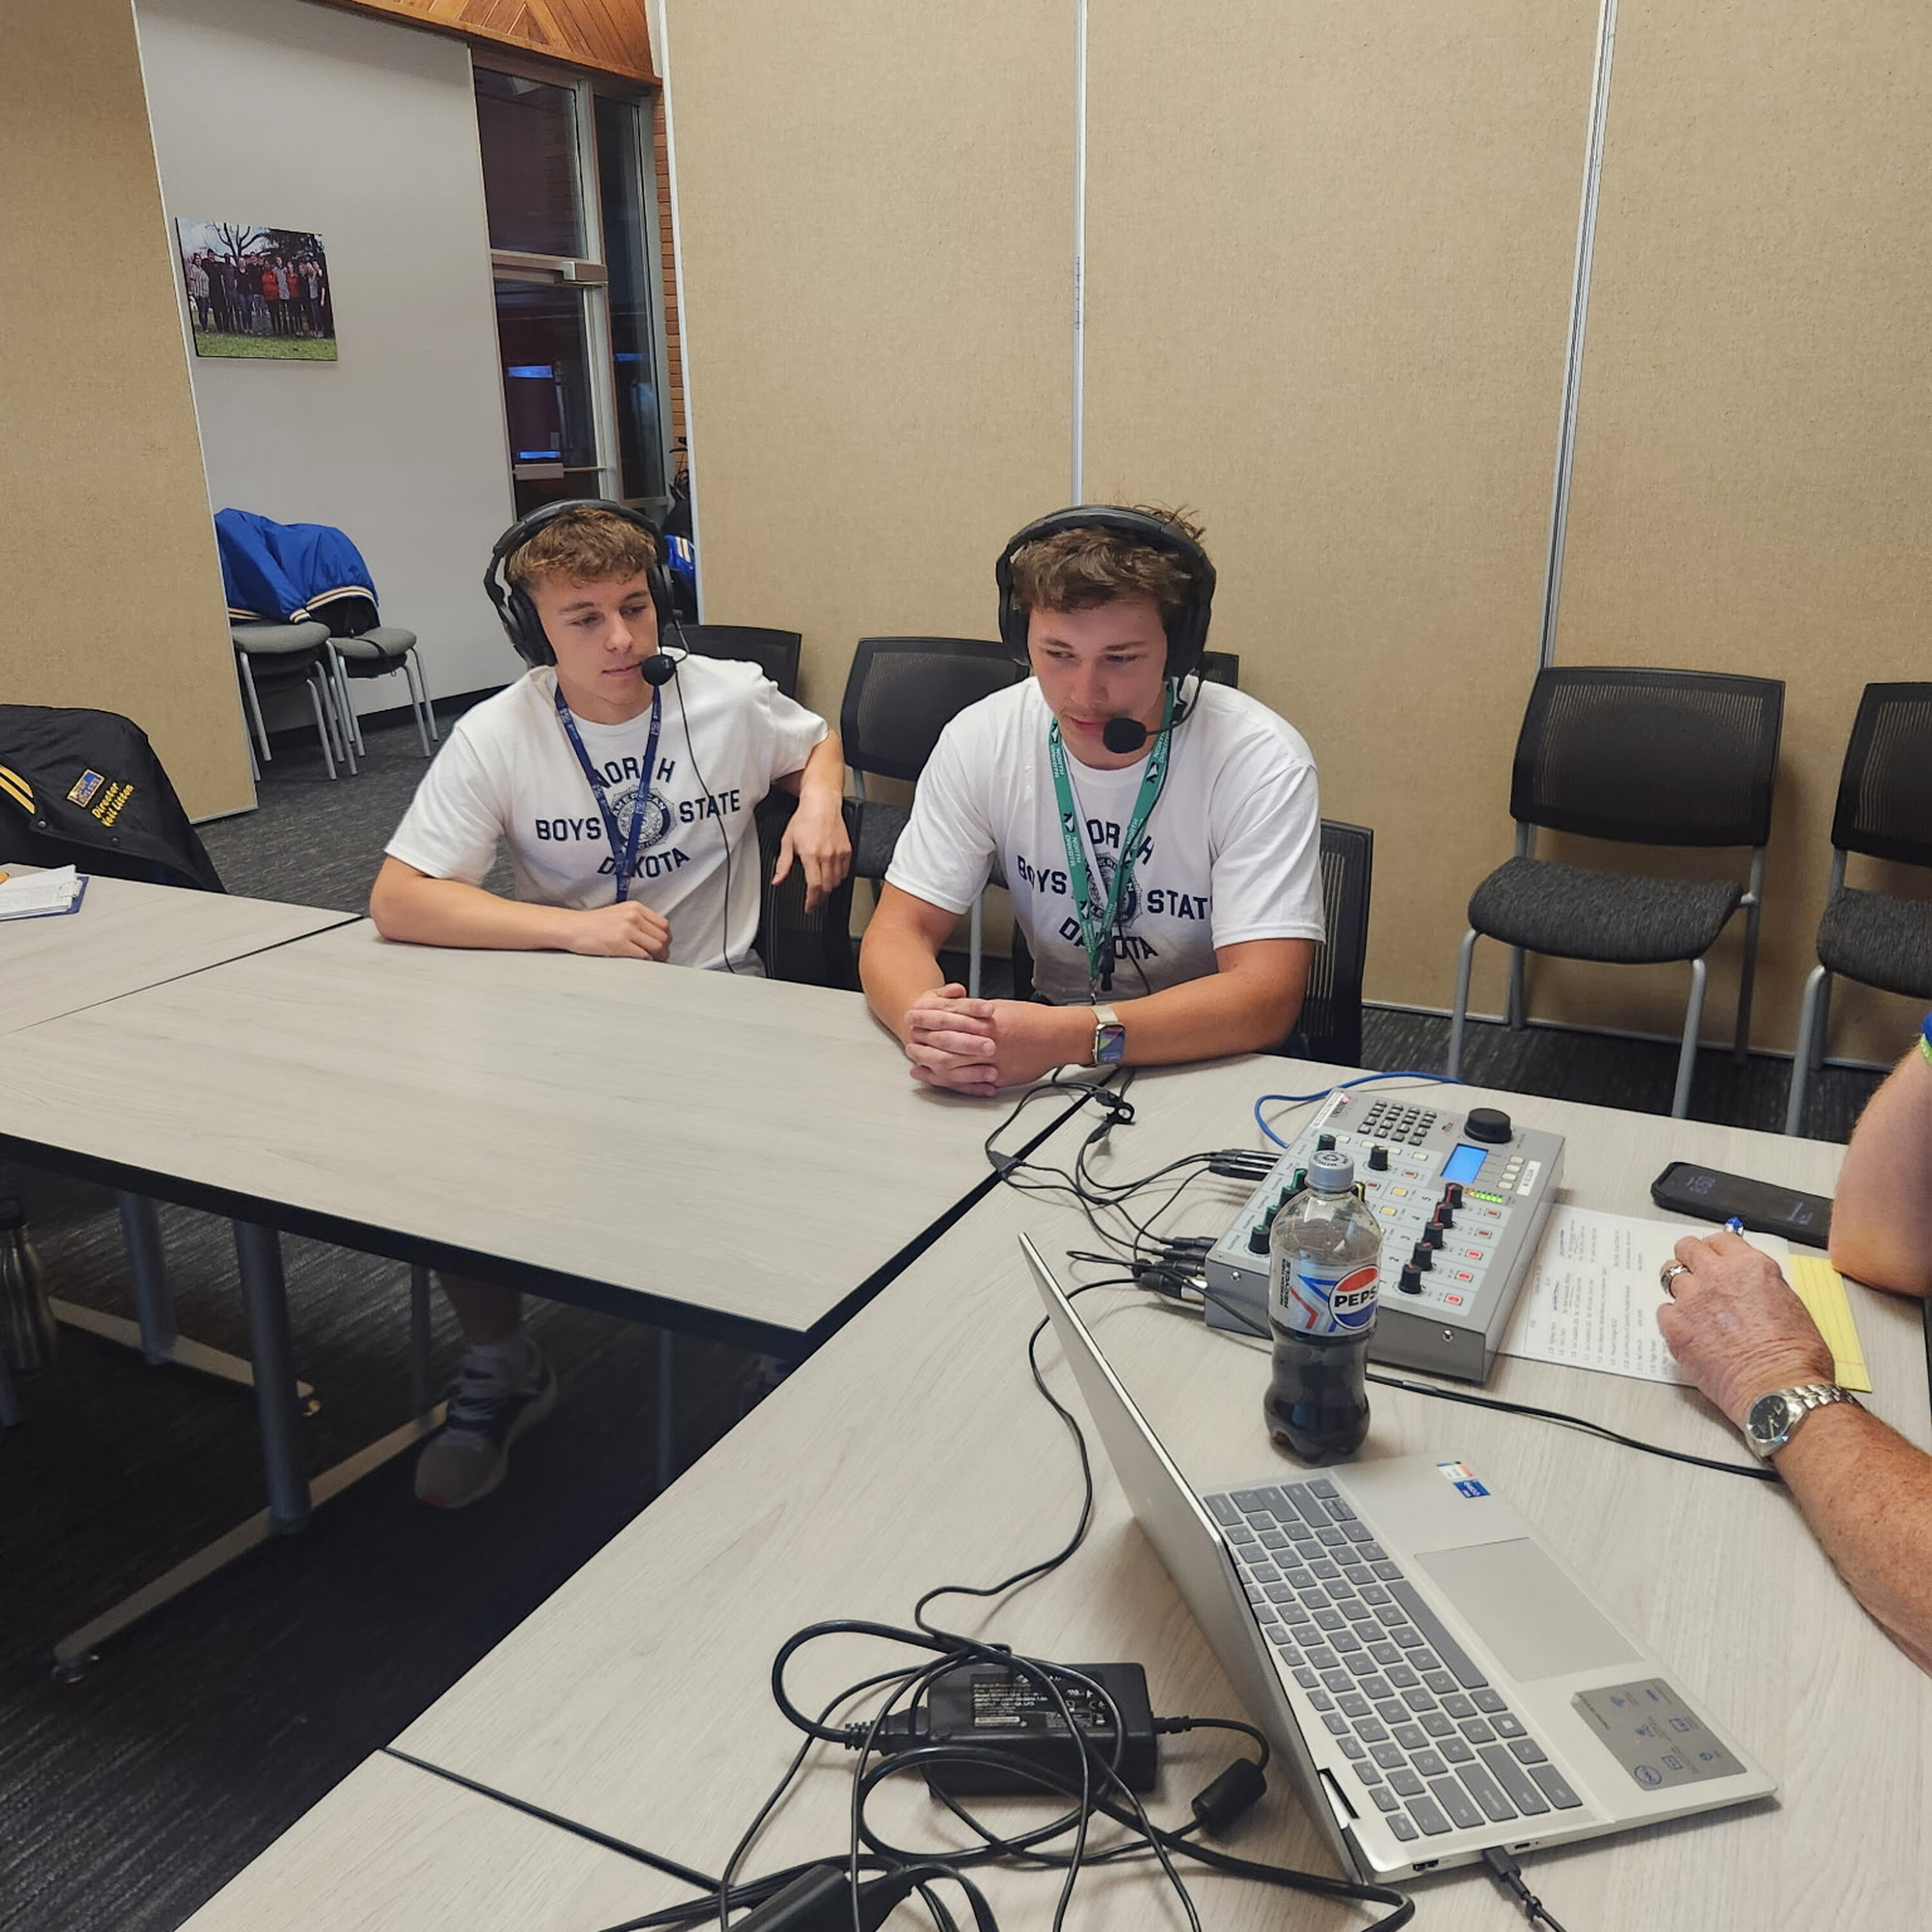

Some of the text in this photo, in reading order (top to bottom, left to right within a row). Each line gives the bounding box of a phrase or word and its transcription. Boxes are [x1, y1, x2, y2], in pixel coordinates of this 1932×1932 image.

[592, 757, 676, 790] NORH
[91, 782, 119, 819] Director
[536, 817, 601, 842] BOYS
[679, 790, 741, 824] STATE
[1086, 819, 1155, 865] ORH
[597, 848, 690, 878] DKOTA
[1018, 855, 1066, 895] BOYS
[1147, 889, 1209, 920] STAT
[1059, 917, 1158, 960] DOTA
[1334, 1285, 1377, 1307] PEPS
